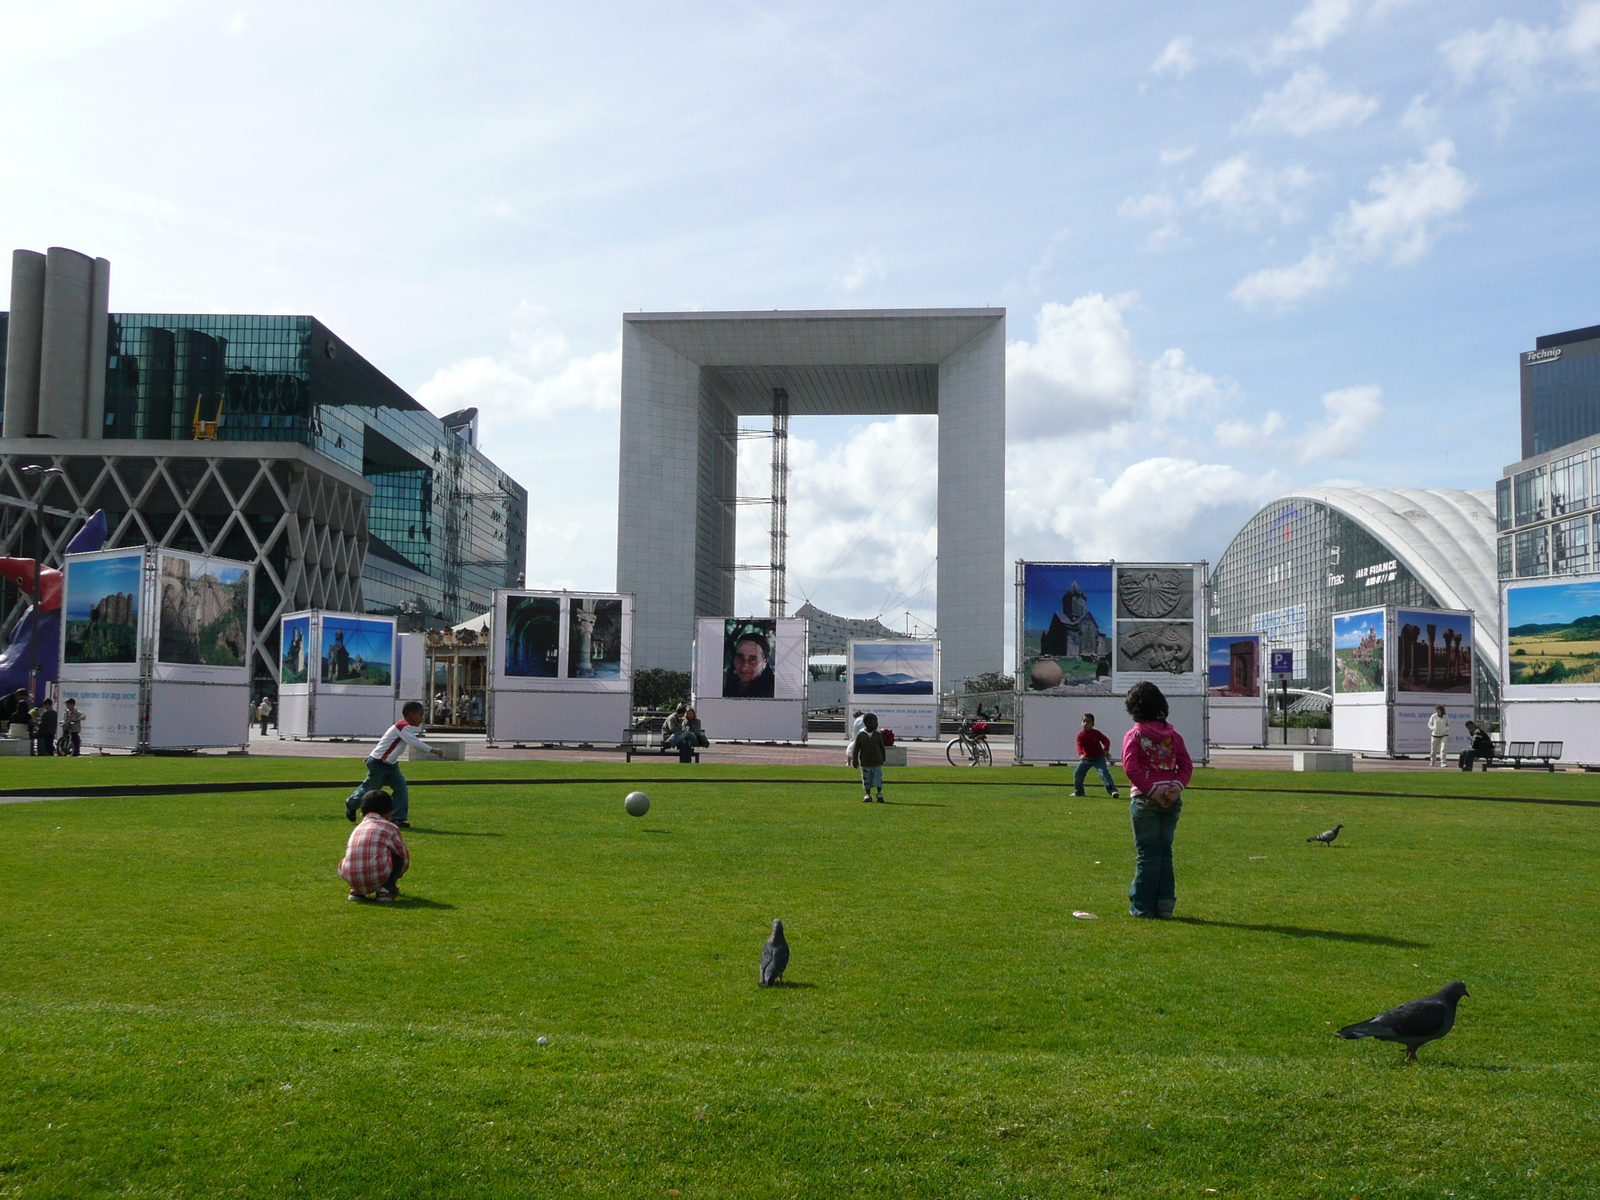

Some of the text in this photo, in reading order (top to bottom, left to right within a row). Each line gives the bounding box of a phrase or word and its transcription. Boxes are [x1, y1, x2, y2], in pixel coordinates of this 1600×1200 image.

[1526, 347, 1561, 360] Technip
[1355, 559, 1397, 579] AIR FRANCE
[1328, 572, 1345, 587] fnac
[1274, 653, 1284, 666] P
